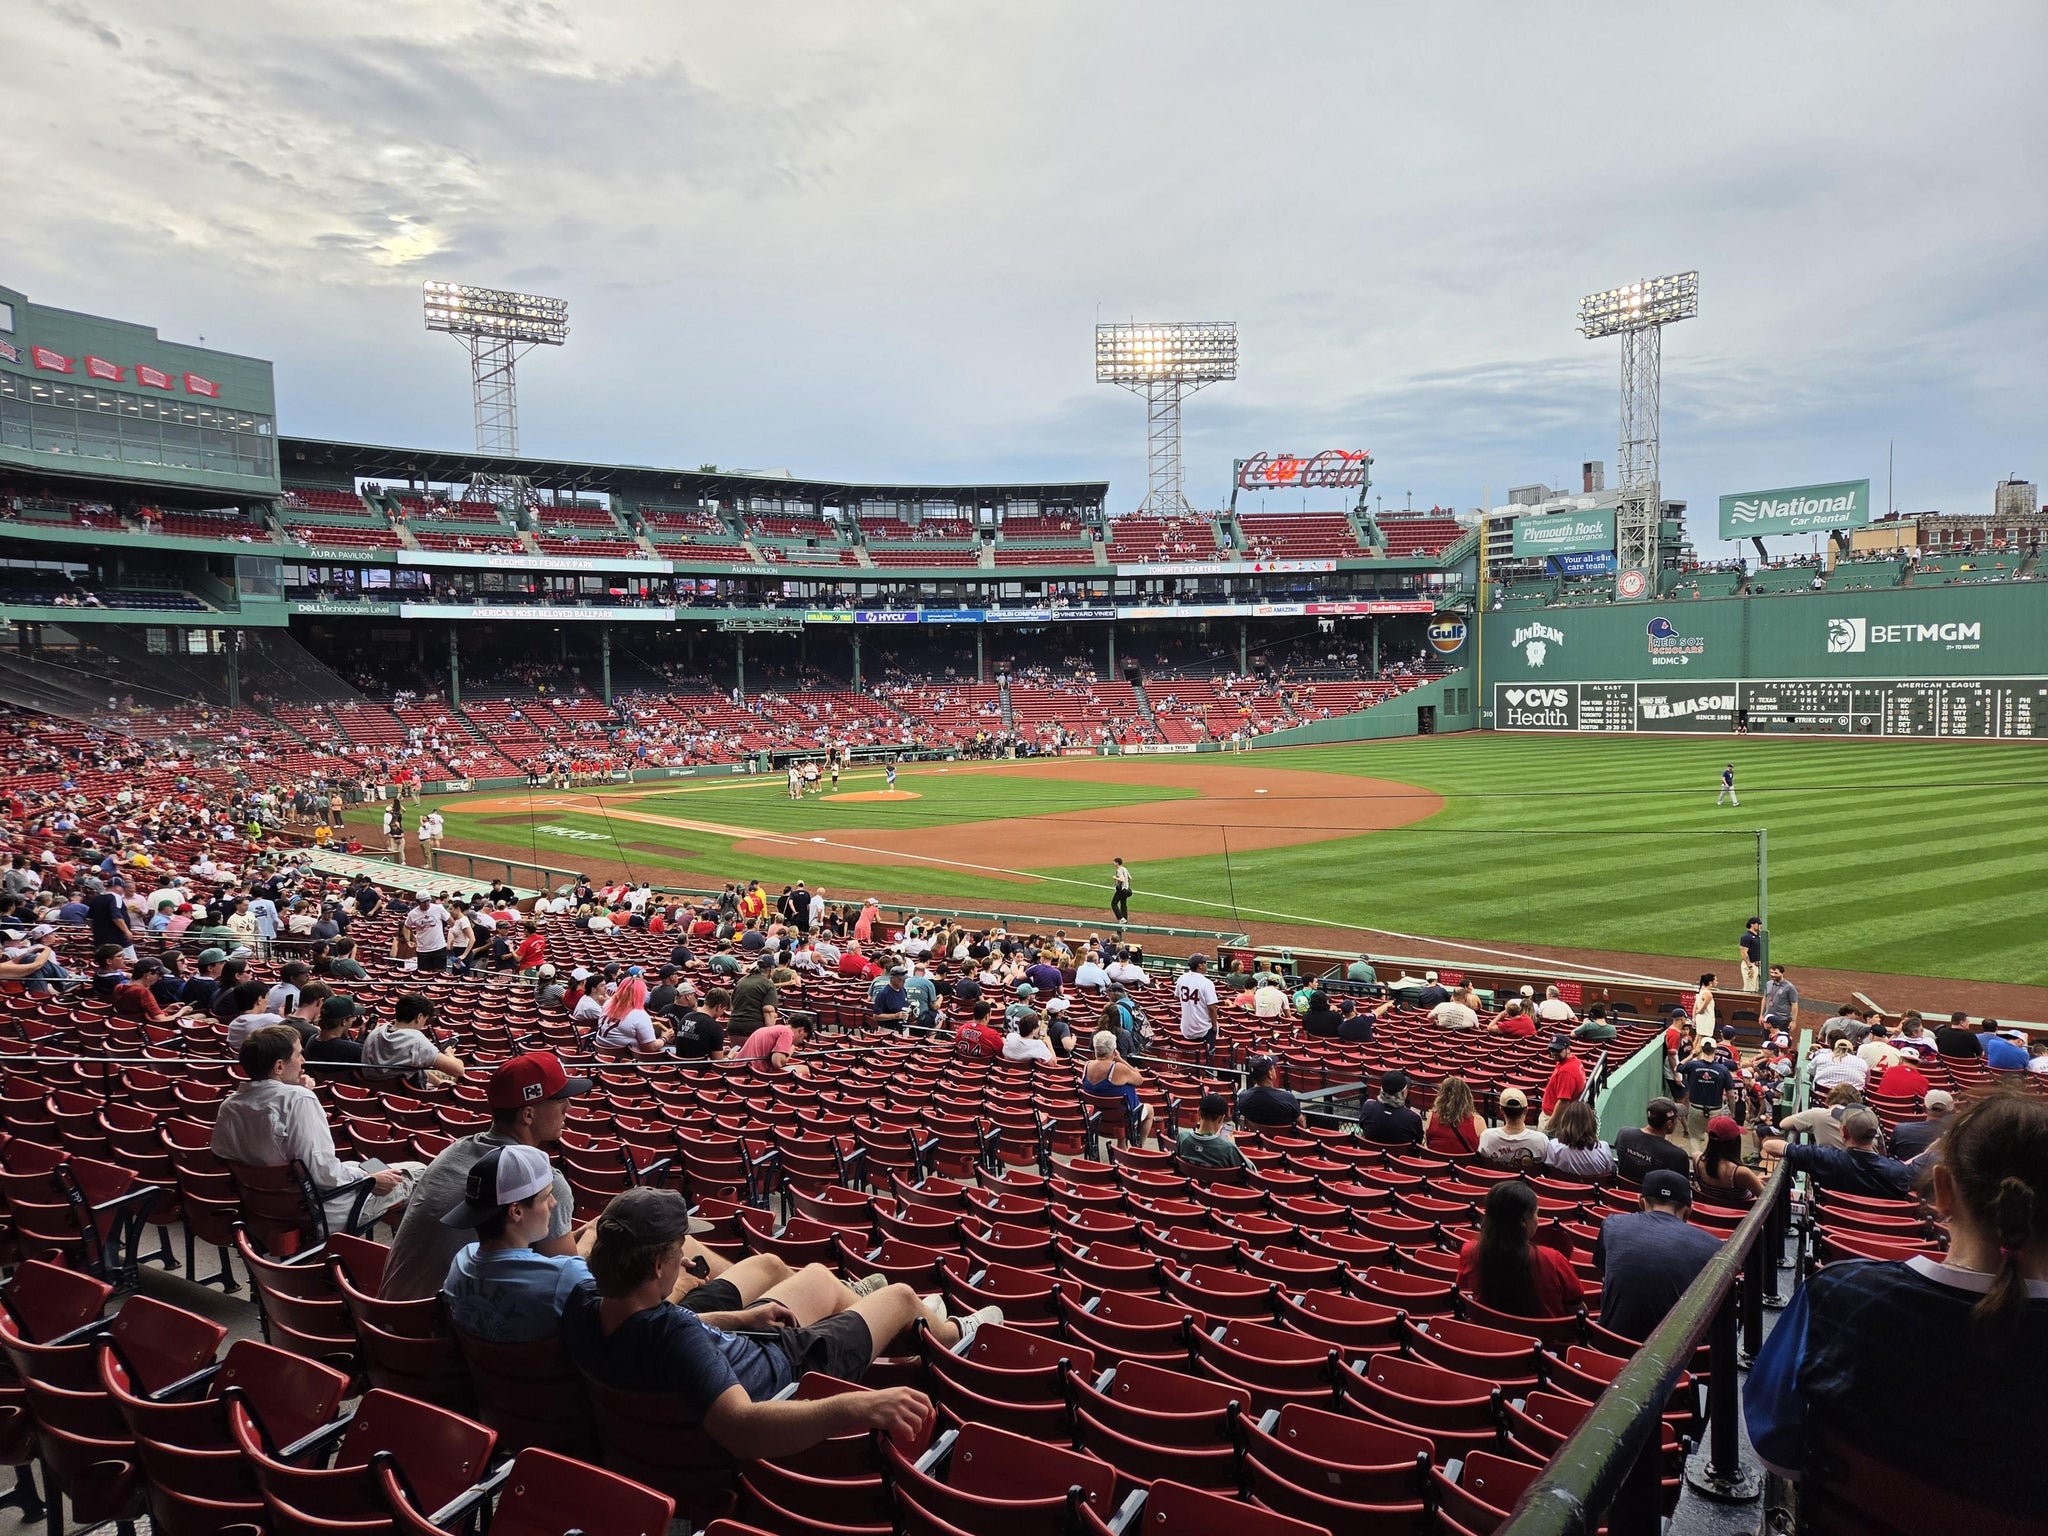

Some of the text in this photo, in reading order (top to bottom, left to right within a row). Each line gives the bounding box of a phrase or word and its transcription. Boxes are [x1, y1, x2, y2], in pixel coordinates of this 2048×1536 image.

[1239, 450, 1366, 491] Coca-Cola
[1758, 491, 1856, 518] National
[1790, 513, 1850, 526] Car Rental
[1523, 521, 1603, 542] Plymouth Rock
[338, 551, 374, 560] PAVILION
[488, 558, 525, 566] WELCOME
[539, 560, 570, 568] FENWAY
[1148, 566, 1183, 574] TONIGHT'S
[322, 605, 369, 614] Technologies
[472, 609, 613, 618] AMERICA'S MOST BELOVED BALLPARK
[1428, 624, 1464, 640] Gulf
[1871, 622, 1981, 643] BETMGM
[1653, 637, 1704, 646] RED SOX
[1652, 646, 1704, 655] SCHOLARS
[1652, 657, 1679, 665] BIDMC
[1525, 688, 1568, 707] CVS
[1483, 710, 1493, 718] 310
[1508, 708, 1568, 726] Health
[1181, 986, 1200, 1005] 34
[1628, 1148, 1645, 1160] Hurley
